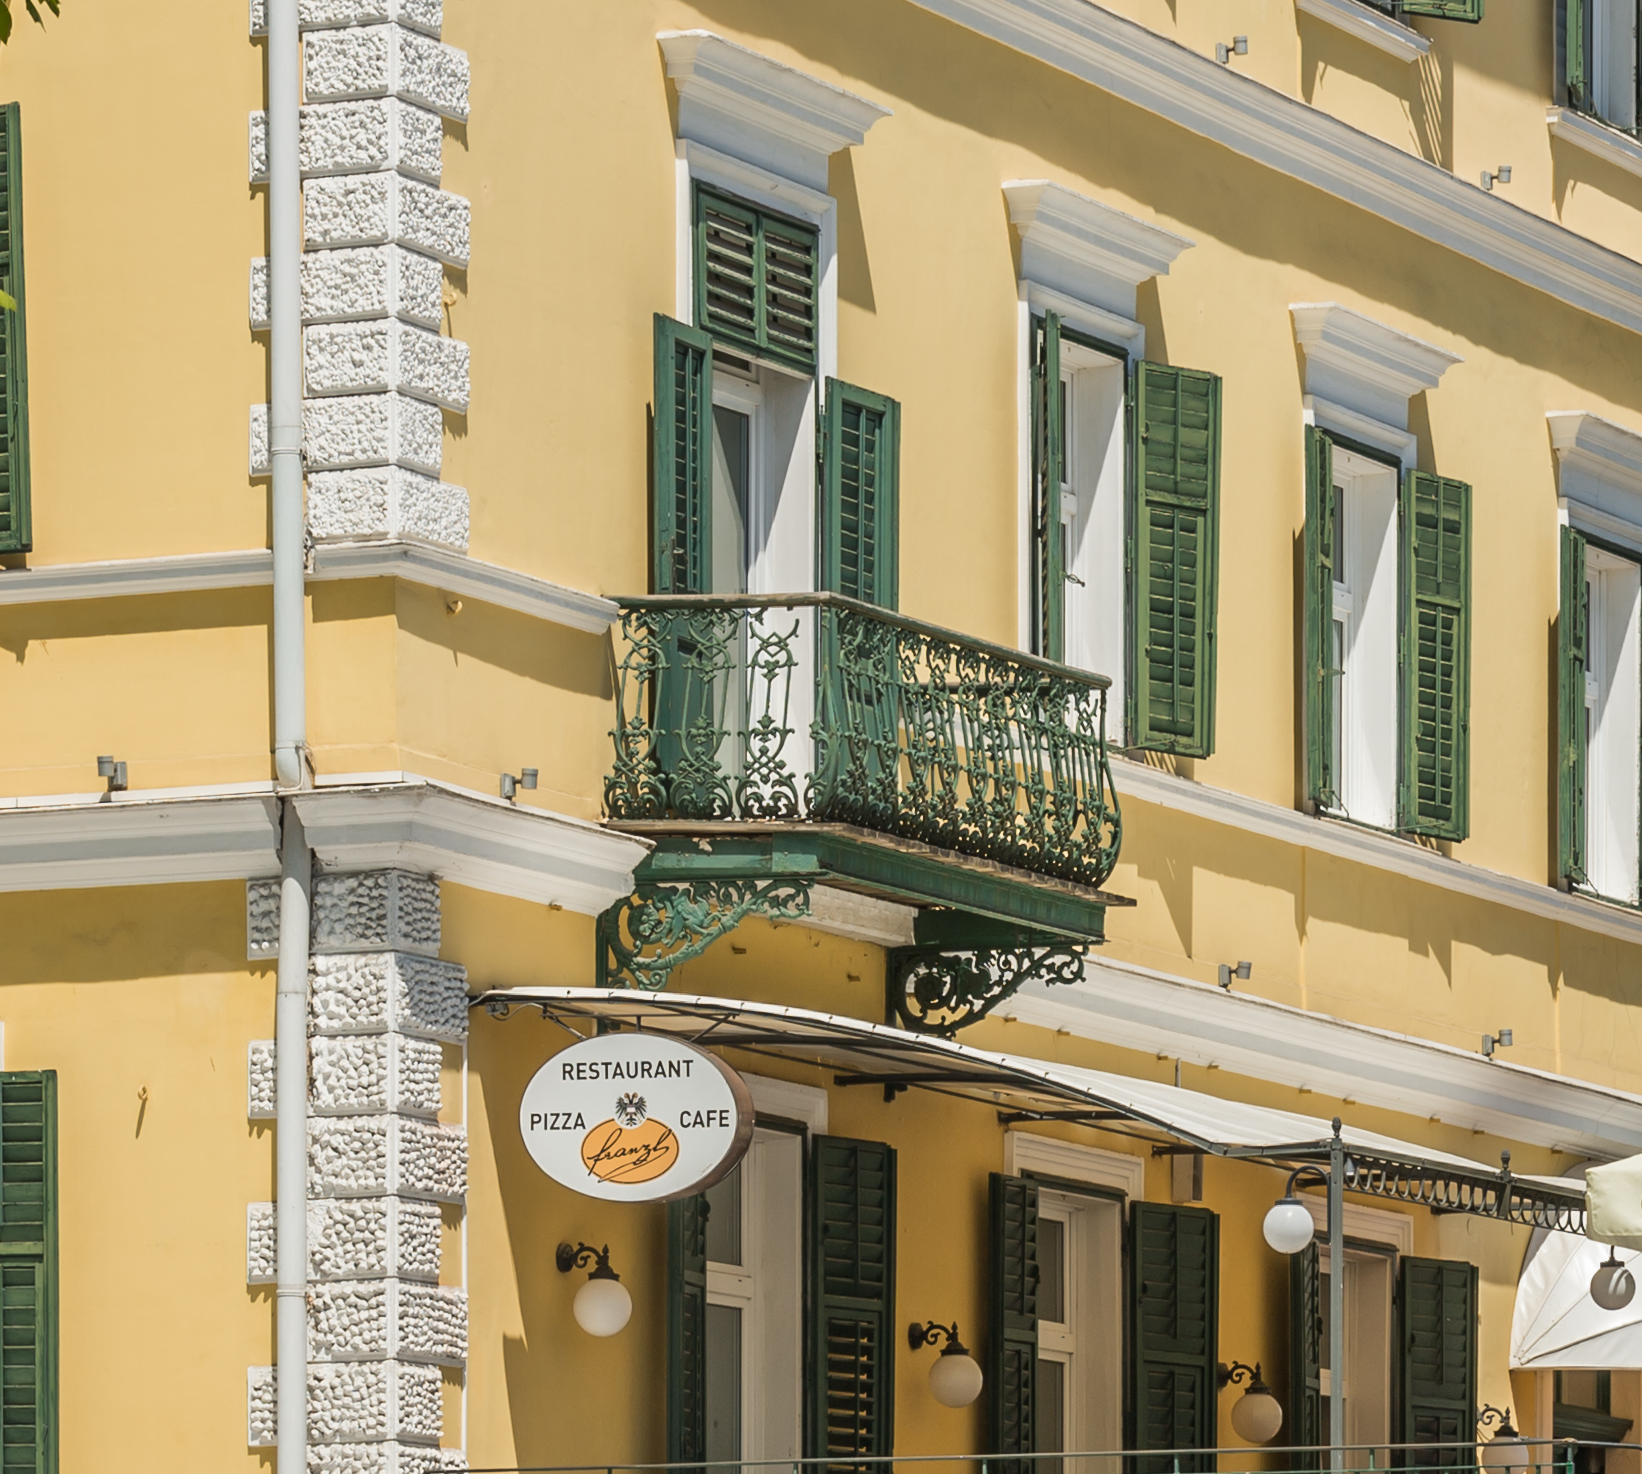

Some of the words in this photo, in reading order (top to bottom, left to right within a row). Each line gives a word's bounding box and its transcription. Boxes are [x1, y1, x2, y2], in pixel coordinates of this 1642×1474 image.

[561, 1060, 694, 1080] RESTAURANT
[530, 1113, 586, 1131] PIZZA
[679, 1110, 730, 1129] CAFE
